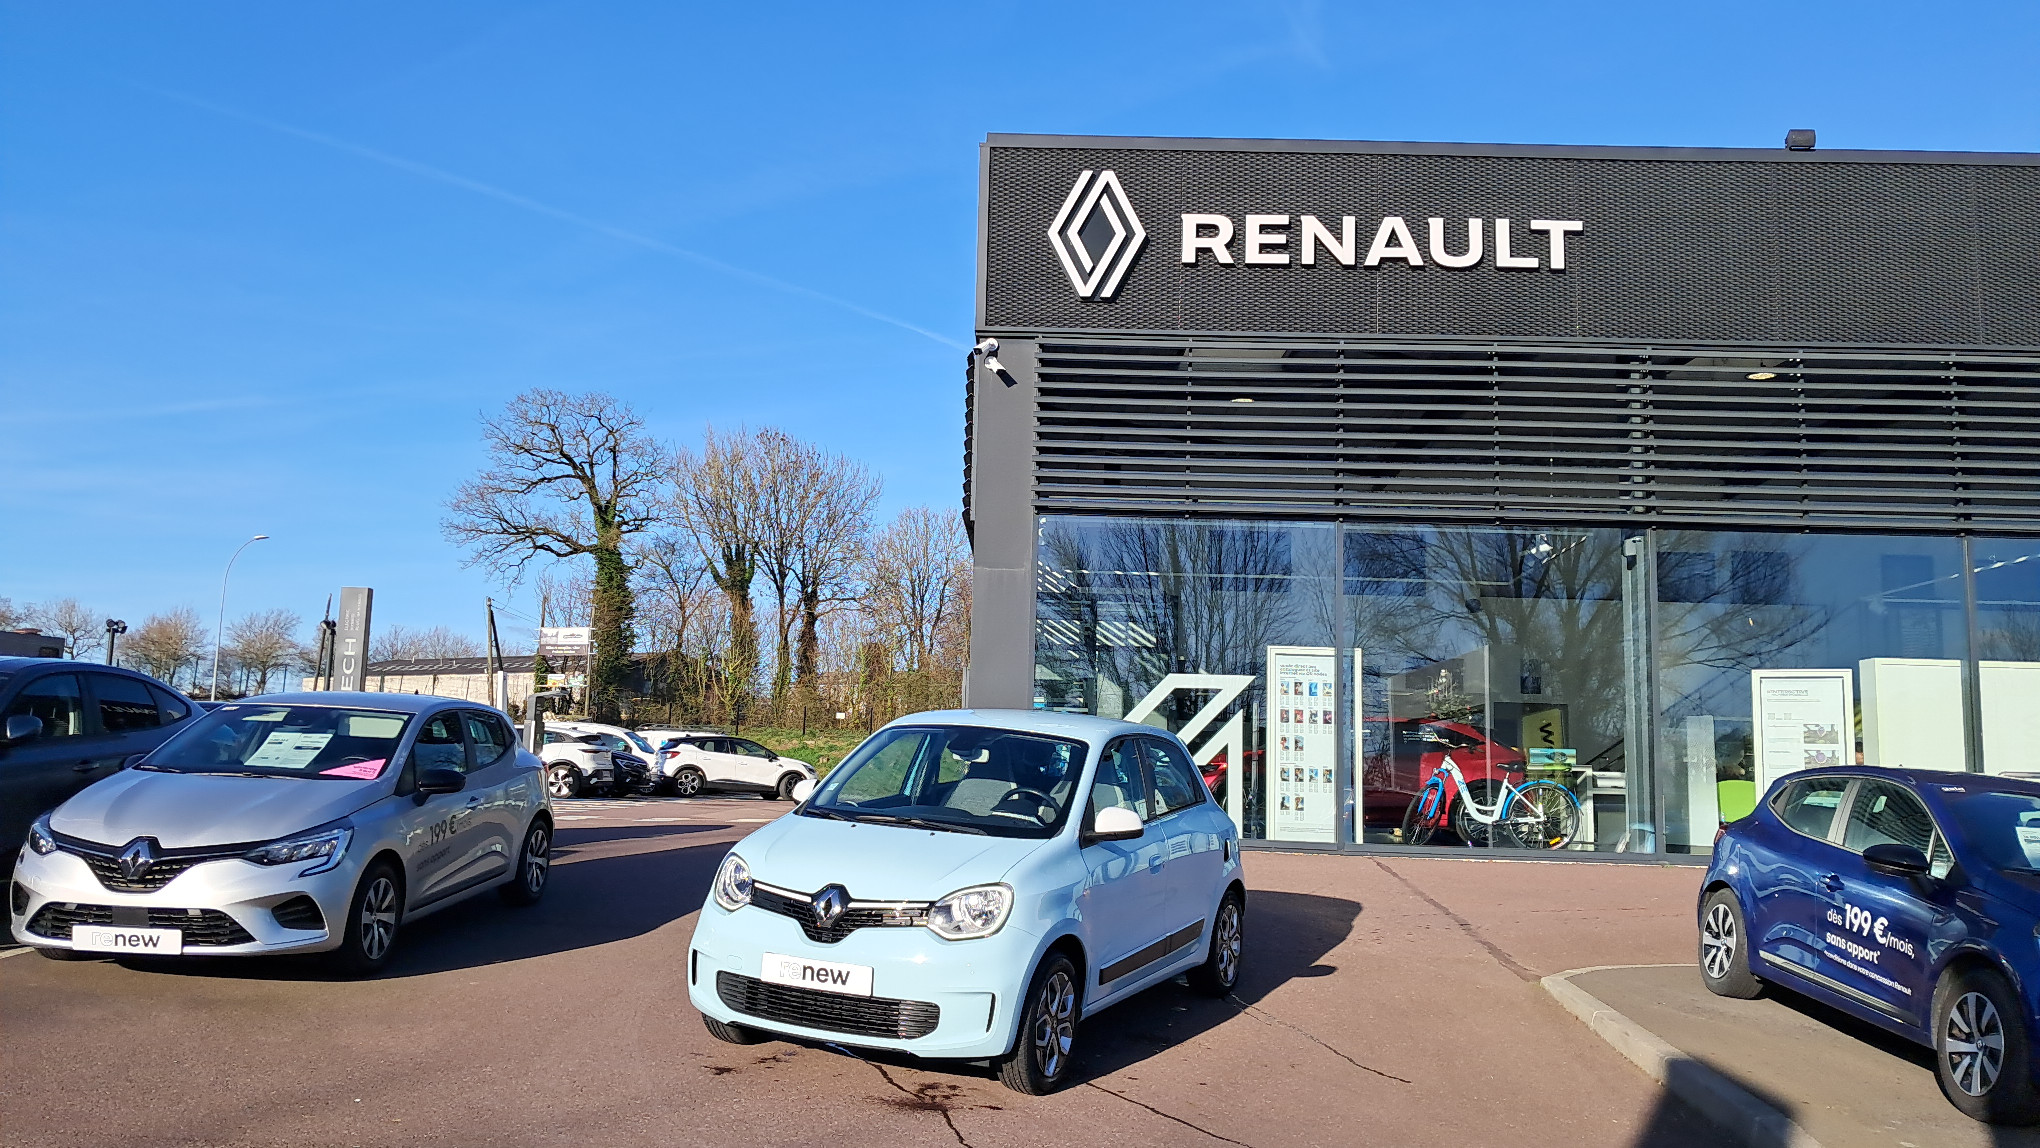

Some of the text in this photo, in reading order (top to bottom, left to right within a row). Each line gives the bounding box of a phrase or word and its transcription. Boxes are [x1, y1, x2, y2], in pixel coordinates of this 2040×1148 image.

[1180, 213, 1584, 271] RENAULT
[430, 819, 447, 846] 199
[1827, 908, 1843, 926] dès
[1845, 903, 1871, 937] 199
[91, 931, 160, 948] renew
[1826, 931, 1847, 950] sans
[779, 961, 851, 986] renew
